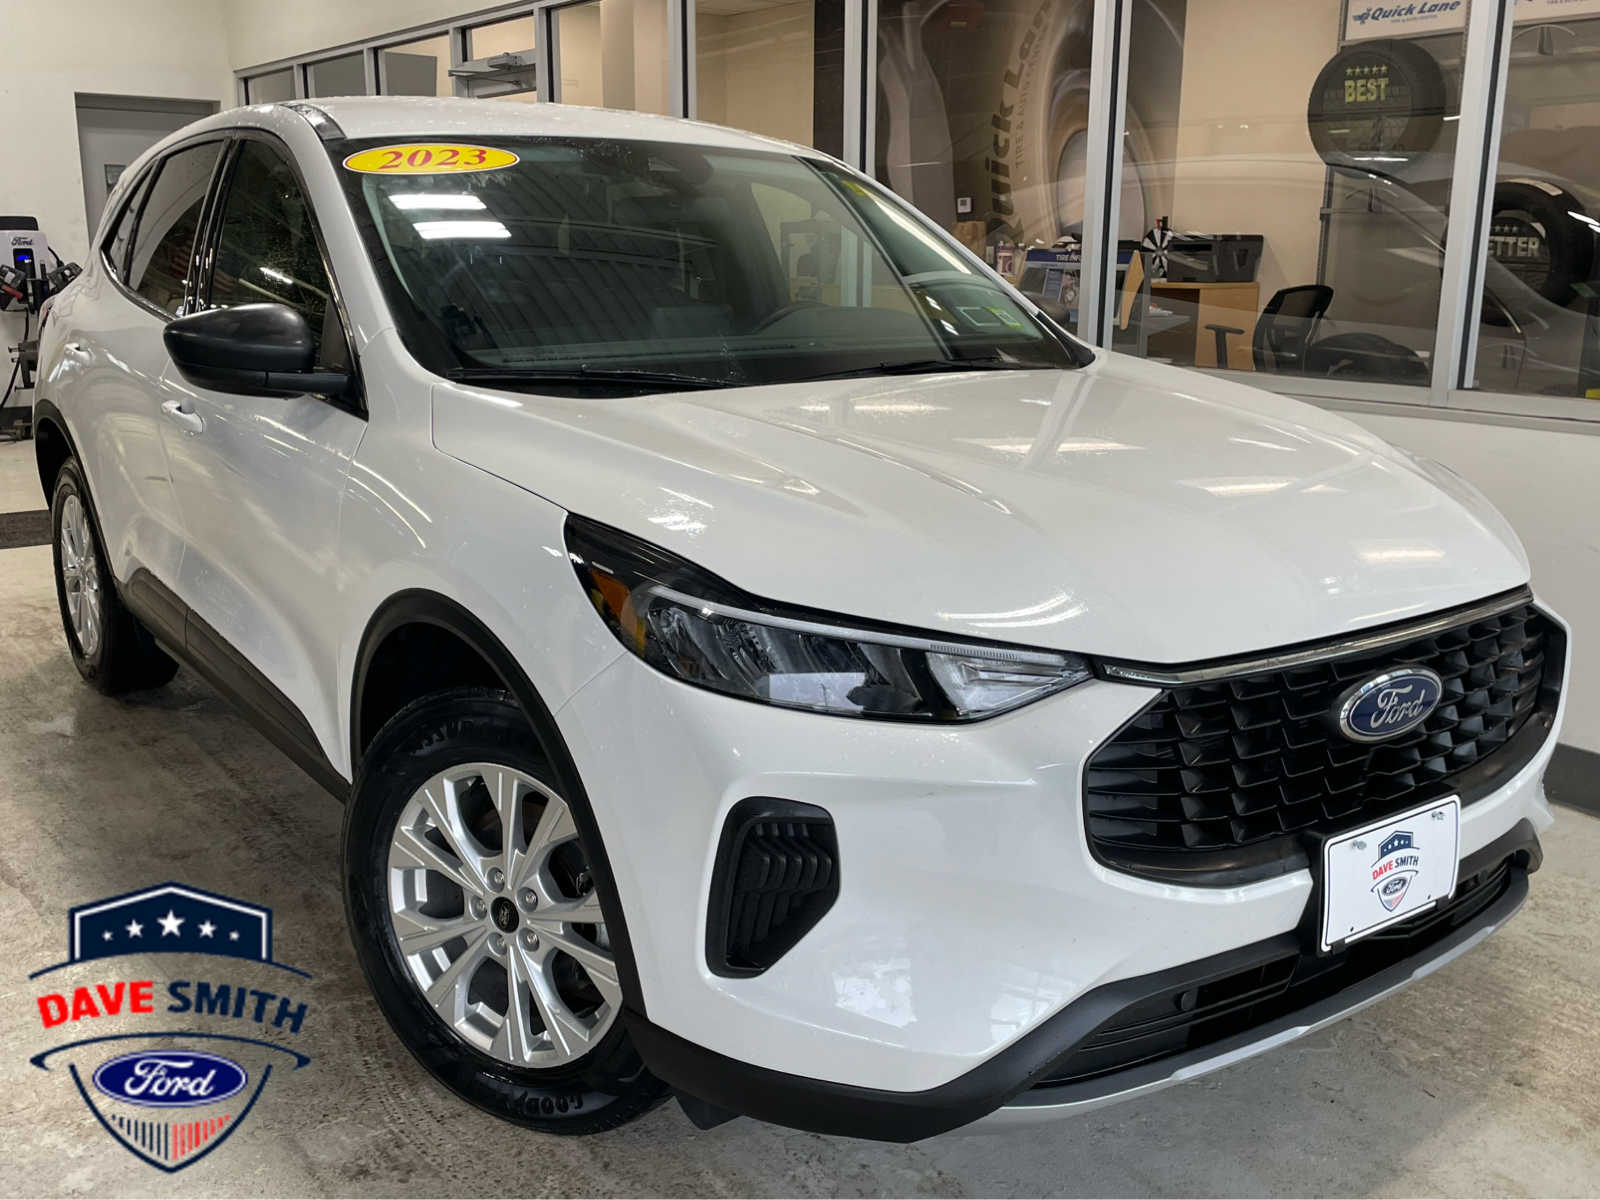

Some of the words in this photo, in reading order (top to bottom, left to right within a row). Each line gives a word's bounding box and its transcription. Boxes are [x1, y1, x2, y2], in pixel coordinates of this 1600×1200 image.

[1371, 4, 1416, 20] Quick
[1418, 1, 1460, 14] Lane
[1345, 77, 1389, 102] BEST
[378, 149, 487, 170] 2023
[1015, 135, 1025, 168] TIRE
[11, 237, 33, 246] Ford
[1488, 236, 1540, 256] ETTER
[1371, 684, 1426, 729] Ford
[1372, 860, 1393, 880] DAVE
[1394, 856, 1419, 868] SMITH
